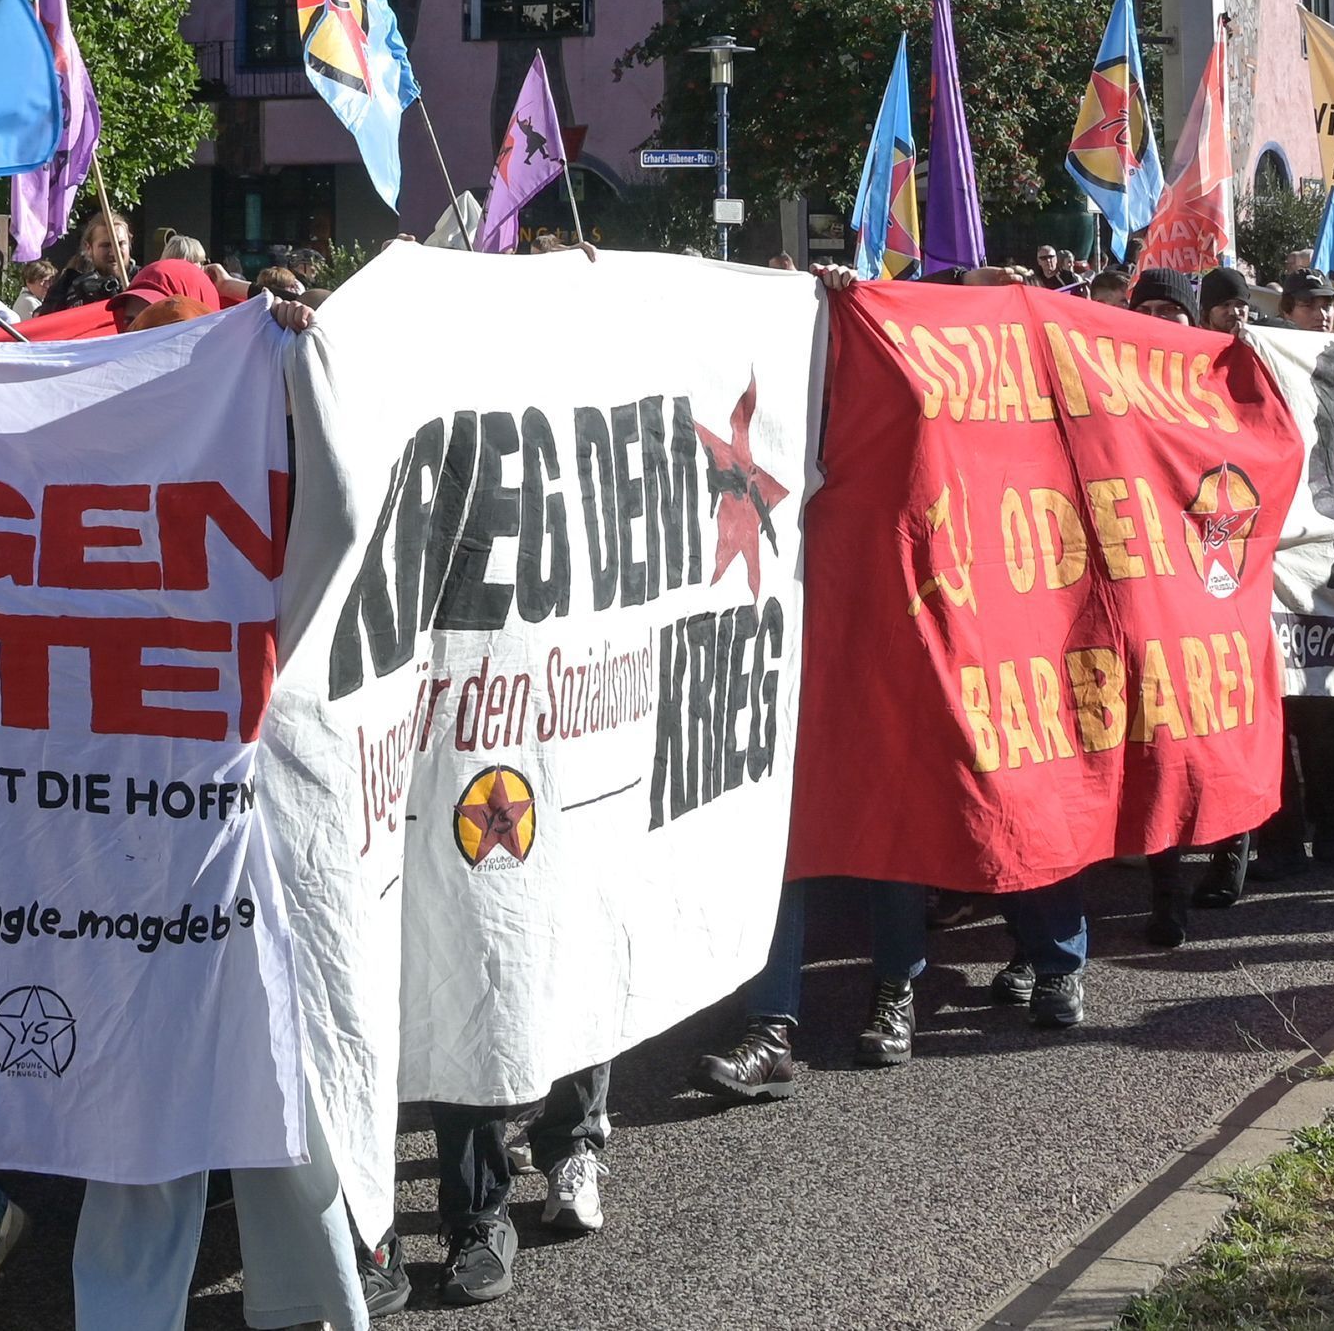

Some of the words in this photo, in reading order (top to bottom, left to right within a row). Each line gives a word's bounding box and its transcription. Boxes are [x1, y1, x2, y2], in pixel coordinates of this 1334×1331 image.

[643, 153, 714, 164] Erhard-Hübener-Platz
[573, 395, 703, 611] DEM
[1001, 476, 1176, 594] ODER
[454, 656, 529, 752] den
[537, 626, 654, 744] Sozialismus!
[958, 631, 1255, 773] BARBAREI
[648, 597, 784, 833] KRIEG
[38, 771, 111, 815] DIE
[484, 855, 514, 865] YOUNG
[19, 1020, 50, 1045] YS
[6, 1070, 49, 1079] STRUGGLE
[15, 1061, 43, 1070] YOUNG
